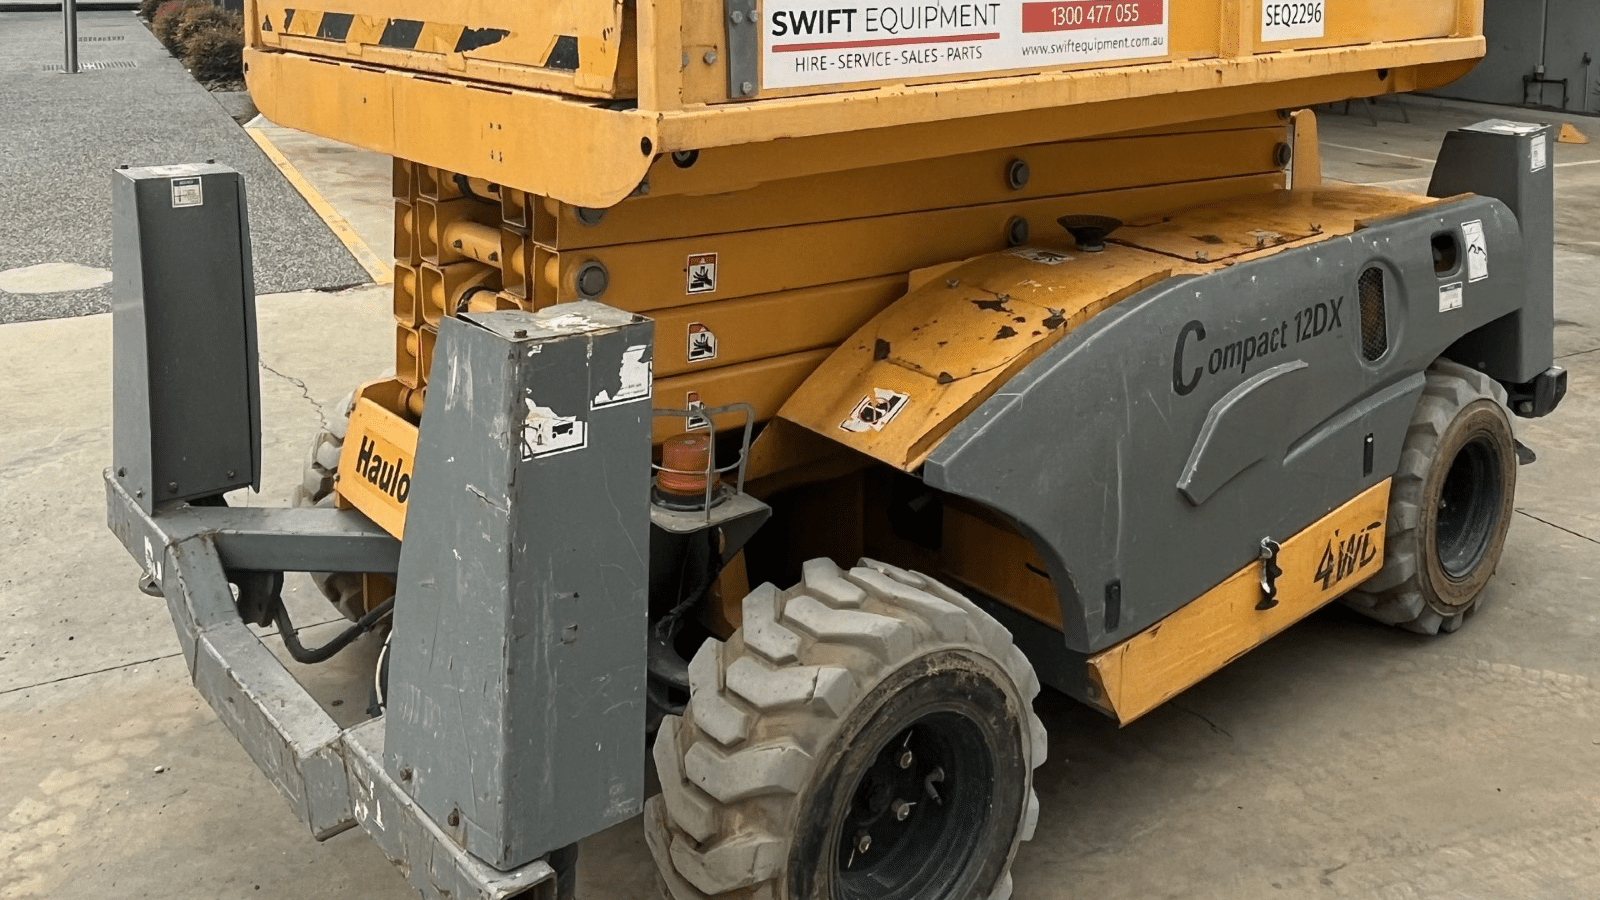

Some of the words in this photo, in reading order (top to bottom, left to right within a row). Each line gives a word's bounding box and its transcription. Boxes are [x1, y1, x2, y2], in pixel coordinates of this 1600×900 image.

[771, 8, 858, 37] SWIFT
[865, 3, 1001, 35] EQUIPMENT
[1051, 6, 1083, 26] 1300
[1086, 4, 1112, 23] 477
[1115, 3, 1140, 23] 055
[1265, 2, 1322, 28] SEQ2296
[1021, 36, 1164, 57] www.swiftequipment.com.au
[1172, 319, 1288, 396] Compact
[1294, 295, 1344, 344] 12DX
